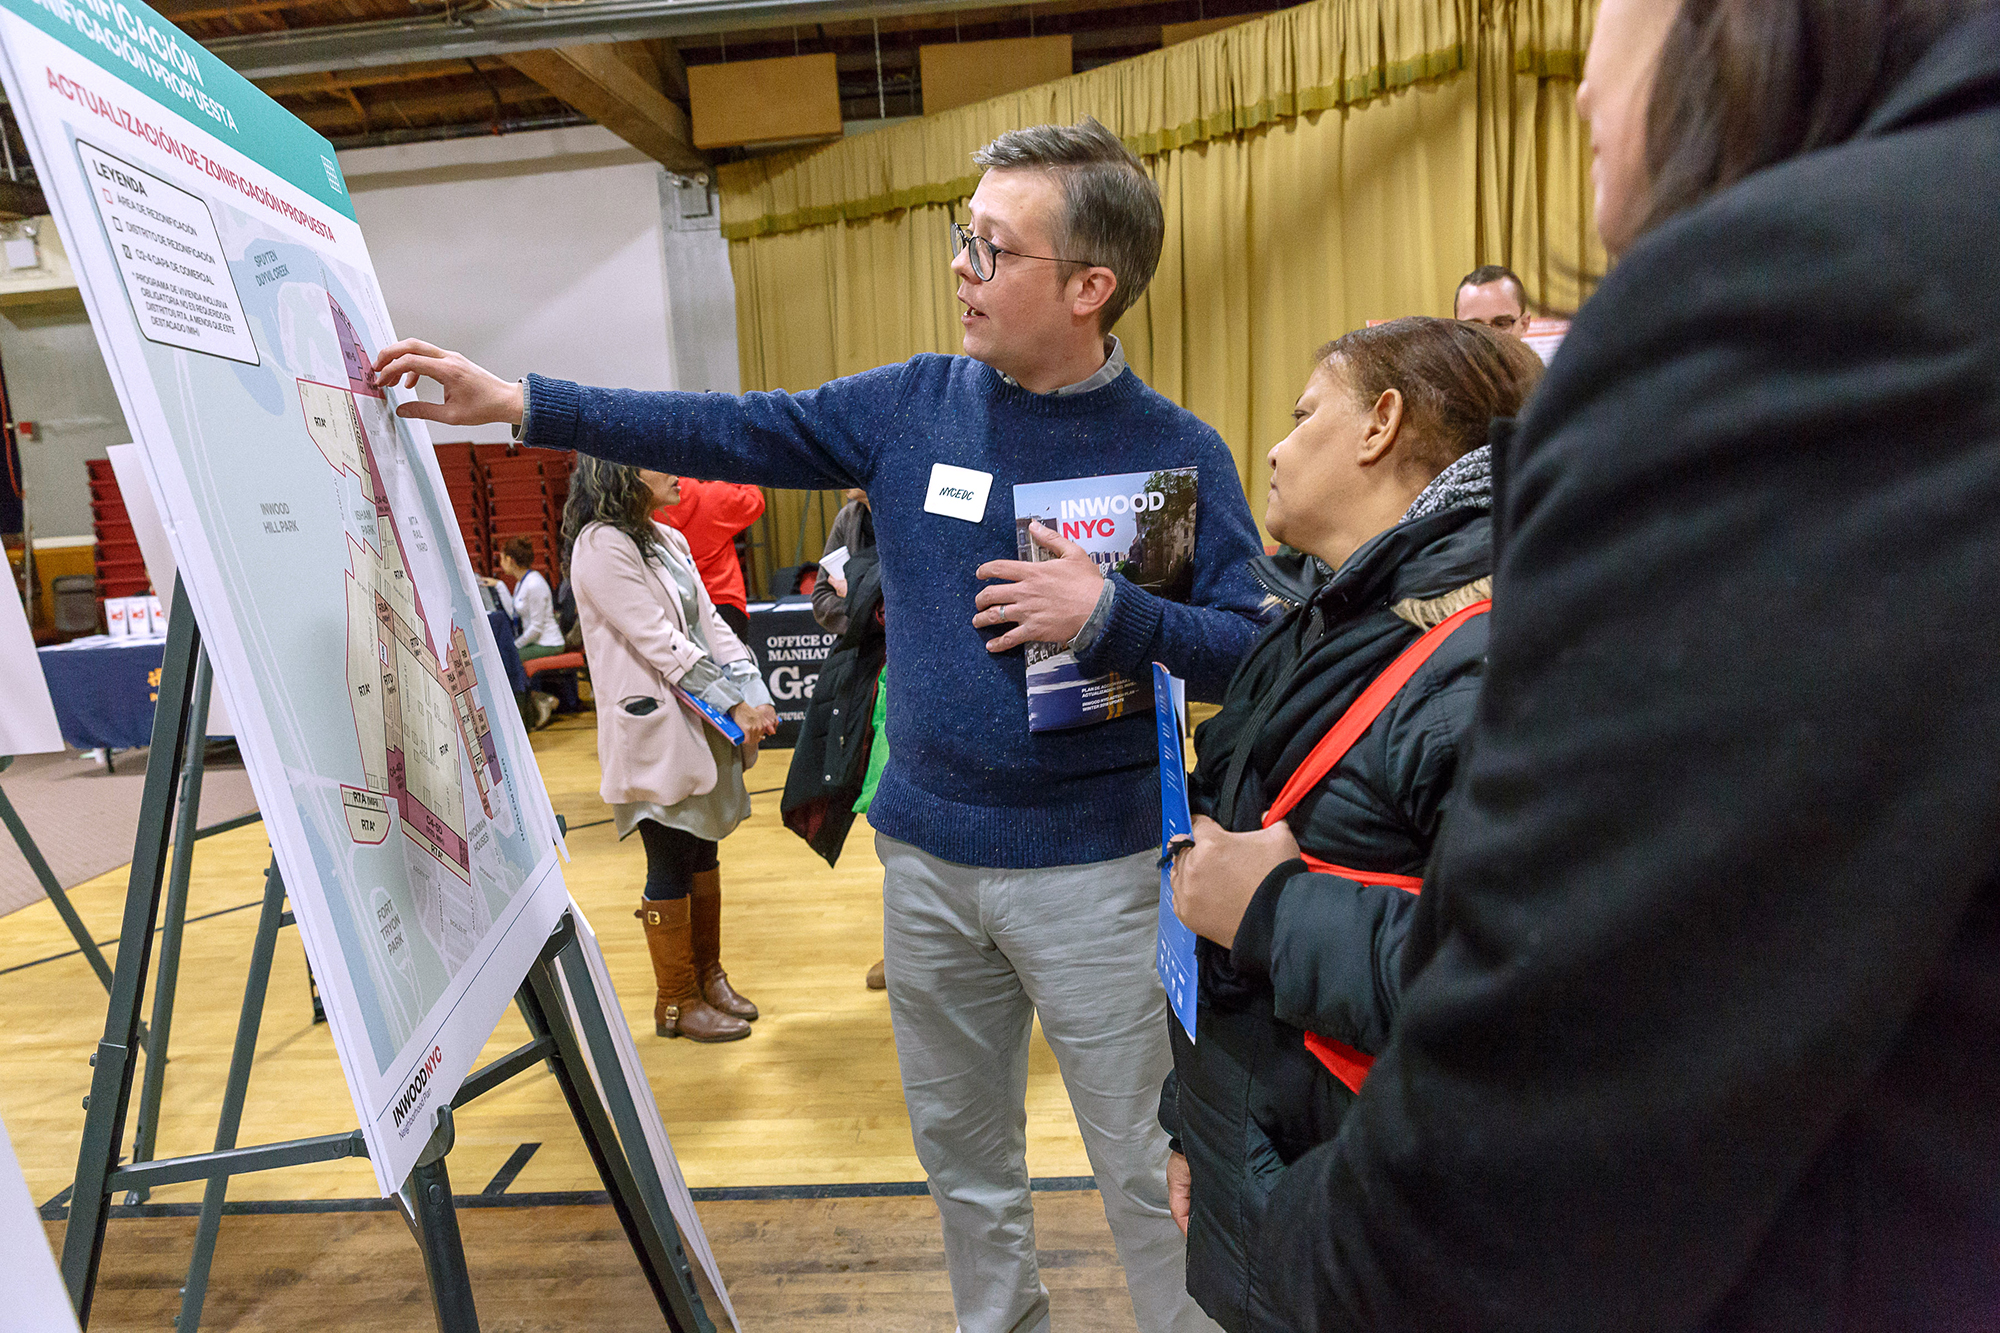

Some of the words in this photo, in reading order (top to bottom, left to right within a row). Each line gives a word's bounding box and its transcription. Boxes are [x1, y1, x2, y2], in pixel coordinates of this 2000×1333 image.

[148, 57, 239, 134] PROPUESTA
[46, 66, 183, 161] ACTUALIZACIÓN
[181, 143, 203, 171] DE
[200, 154, 283, 215] ZONIFICACIÓN
[280, 199, 336, 243] PROPUESTA
[92, 159, 148, 197] LEYENDA
[253, 249, 278, 268] SPUYTEN
[273, 263, 290, 280] CREEK
[938, 486, 975, 501] NYCEDC
[260, 502, 290, 515] INWOOD
[354, 510, 372, 521] ISHAM
[1060, 491, 1165, 520] INWOOD
[262, 521, 281, 534] HILL
[280, 520, 299, 533] PARK
[360, 525, 377, 535] PARK
[1062, 518, 1116, 540] NYC
[766, 634, 820, 648] OFFICE
[768, 648, 830, 662] MANHAT
[769, 666, 819, 700] Ga
[474, 832, 489, 853] HOUSES
[377, 899, 394, 922] FORT
[380, 913, 401, 940] TRYON
[387, 932, 404, 957] PARK
[392, 1045, 442, 1128] INWOODNYC
